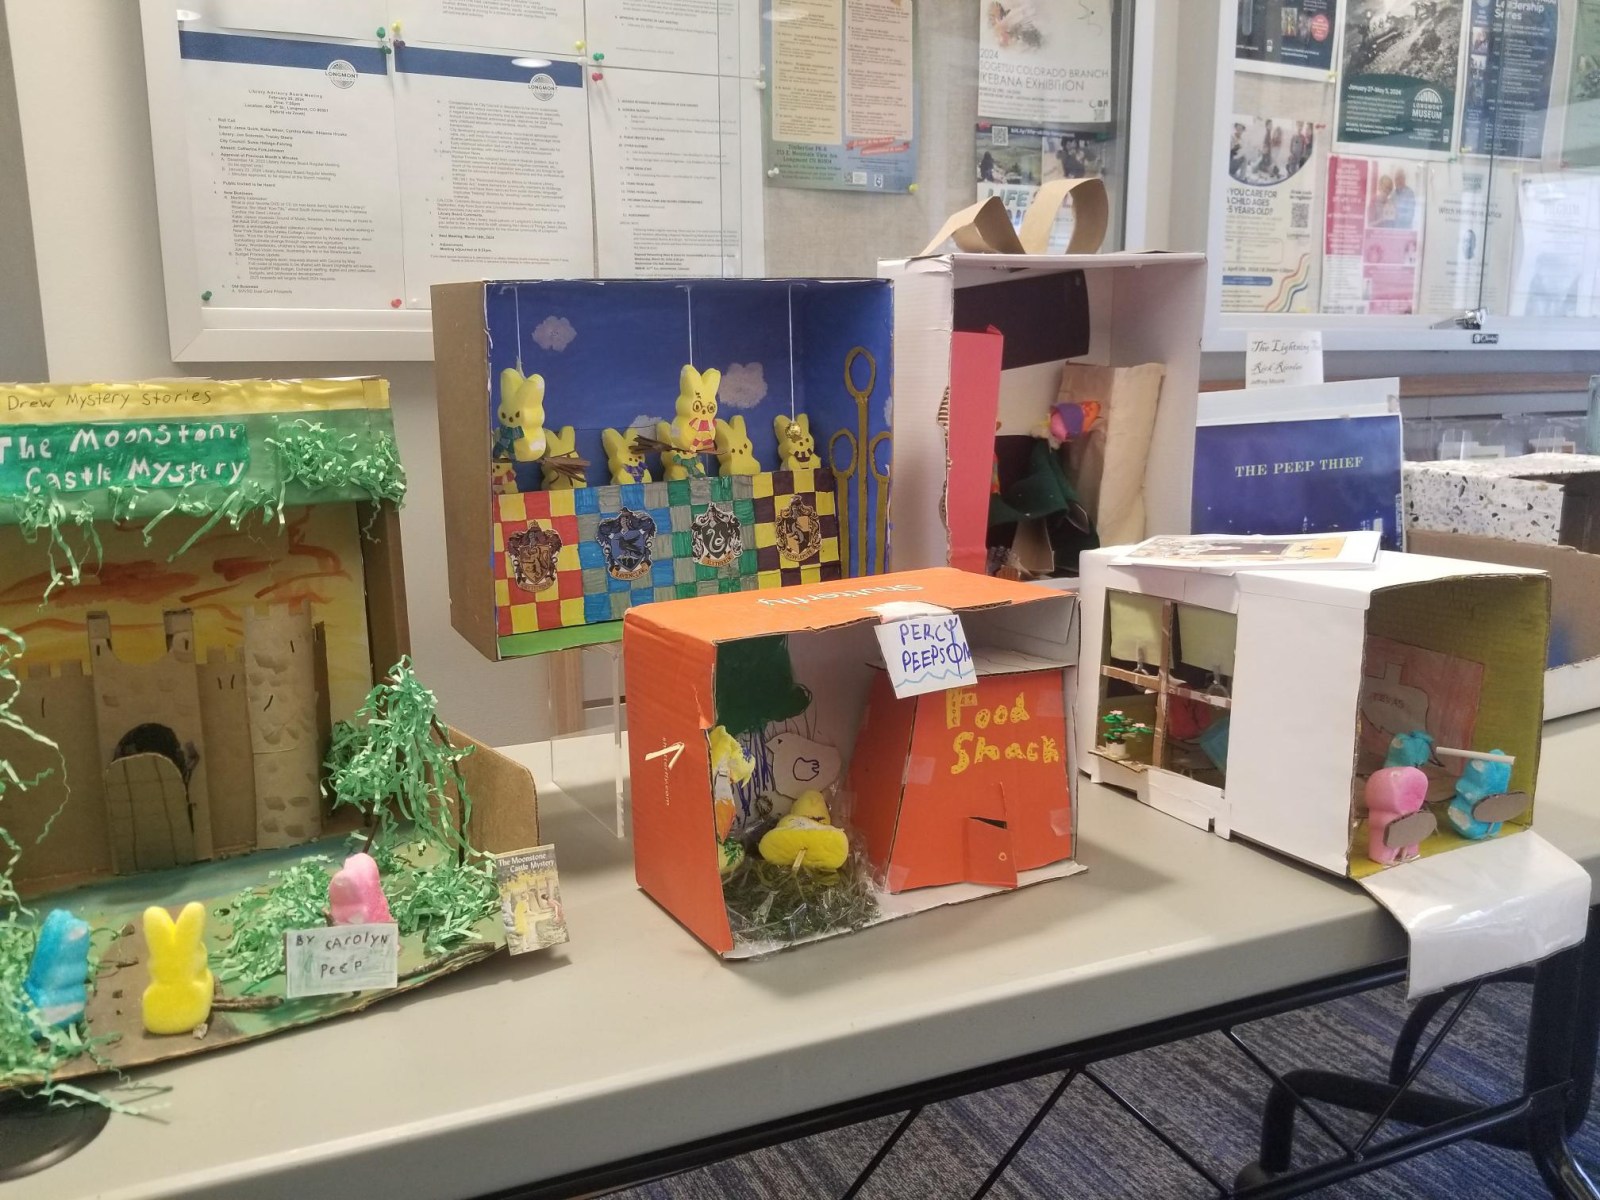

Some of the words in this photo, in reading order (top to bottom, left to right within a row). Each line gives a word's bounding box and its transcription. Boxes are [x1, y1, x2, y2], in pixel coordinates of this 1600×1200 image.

[980, 49, 998, 59] 2024
[1016, 65, 1067, 77] COLORADO
[1069, 69, 1109, 78] BRANCH
[1025, 78, 1084, 91] EXHIBITION
[1411, 109, 1443, 120] MUSEUM
[1230, 188, 1245, 197] YOU
[1245, 189, 1264, 198] CARE
[1264, 190, 1278, 199] FOR
[1231, 197, 1251, 205] CHILD
[1252, 198, 1270, 207] AGES
[1234, 206, 1256, 215] YEARS
[1250, 340, 1270, 353] The
[1271, 339, 1310, 356] Lightning
[8, 395, 56, 411] Drew
[66, 392, 130, 410] Mystery
[0, 435, 52, 464] The
[1234, 464, 1267, 478] THE
[1273, 460, 1315, 474] PEEP
[1319, 456, 1363, 471] THIEF
[26, 463, 112, 494] Castle
[757, 584, 924, 607] Shutterfly
[900, 617, 958, 646] PERCY
[946, 686, 1030, 730] Food
[951, 731, 1059, 775] Shack
[500, 858, 510, 867] The
[511, 853, 547, 865] Moonstone
[510, 863, 529, 873] Castle
[530, 859, 555, 870] Mystery
[296, 934, 316, 947] BY
